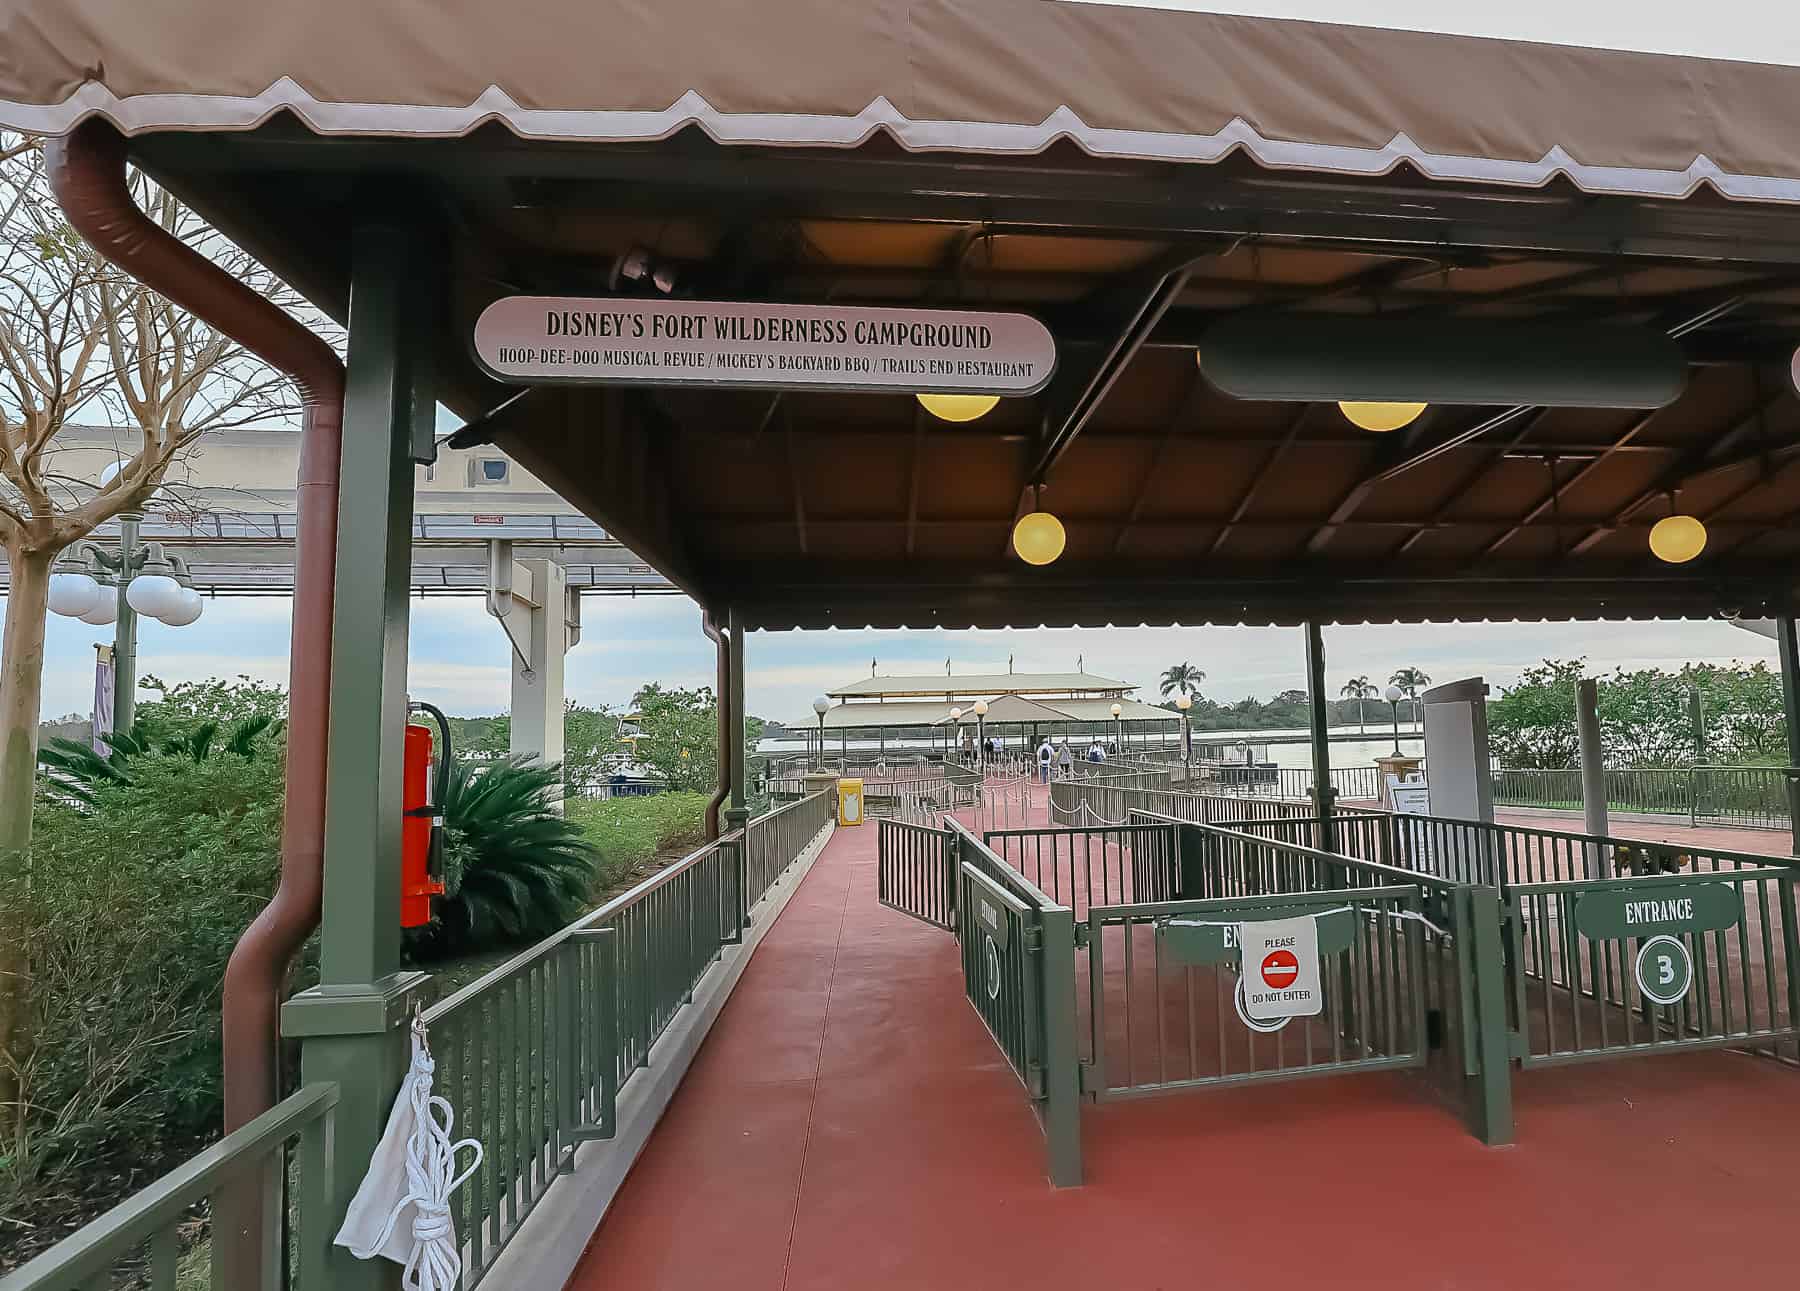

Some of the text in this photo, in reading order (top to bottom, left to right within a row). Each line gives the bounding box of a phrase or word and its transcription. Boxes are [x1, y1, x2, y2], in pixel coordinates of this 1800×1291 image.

[547, 311, 992, 348] DISNEY'S FORT WILDERNESS CAMPGROUND
[499, 347, 599, 364] HOOP-DEE-DOO
[603, 350, 659, 367] MUSICAL
[664, 352, 705, 368] REVUE
[717, 353, 775, 369] MICKEY'S
[779, 355, 841, 371] BACKYARD
[845, 357, 870, 373] BBQ
[881, 358, 926, 374] TRAIL'S
[930, 360, 954, 375] END
[957, 361, 1034, 377] RESTAURANT
[1625, 898, 1694, 924] ENTRANCE
[1265, 937, 1296, 948] PLEASE
[1657, 955, 1675, 985] 3
[1252, 990, 1311, 1004] DO NOT ENTER
